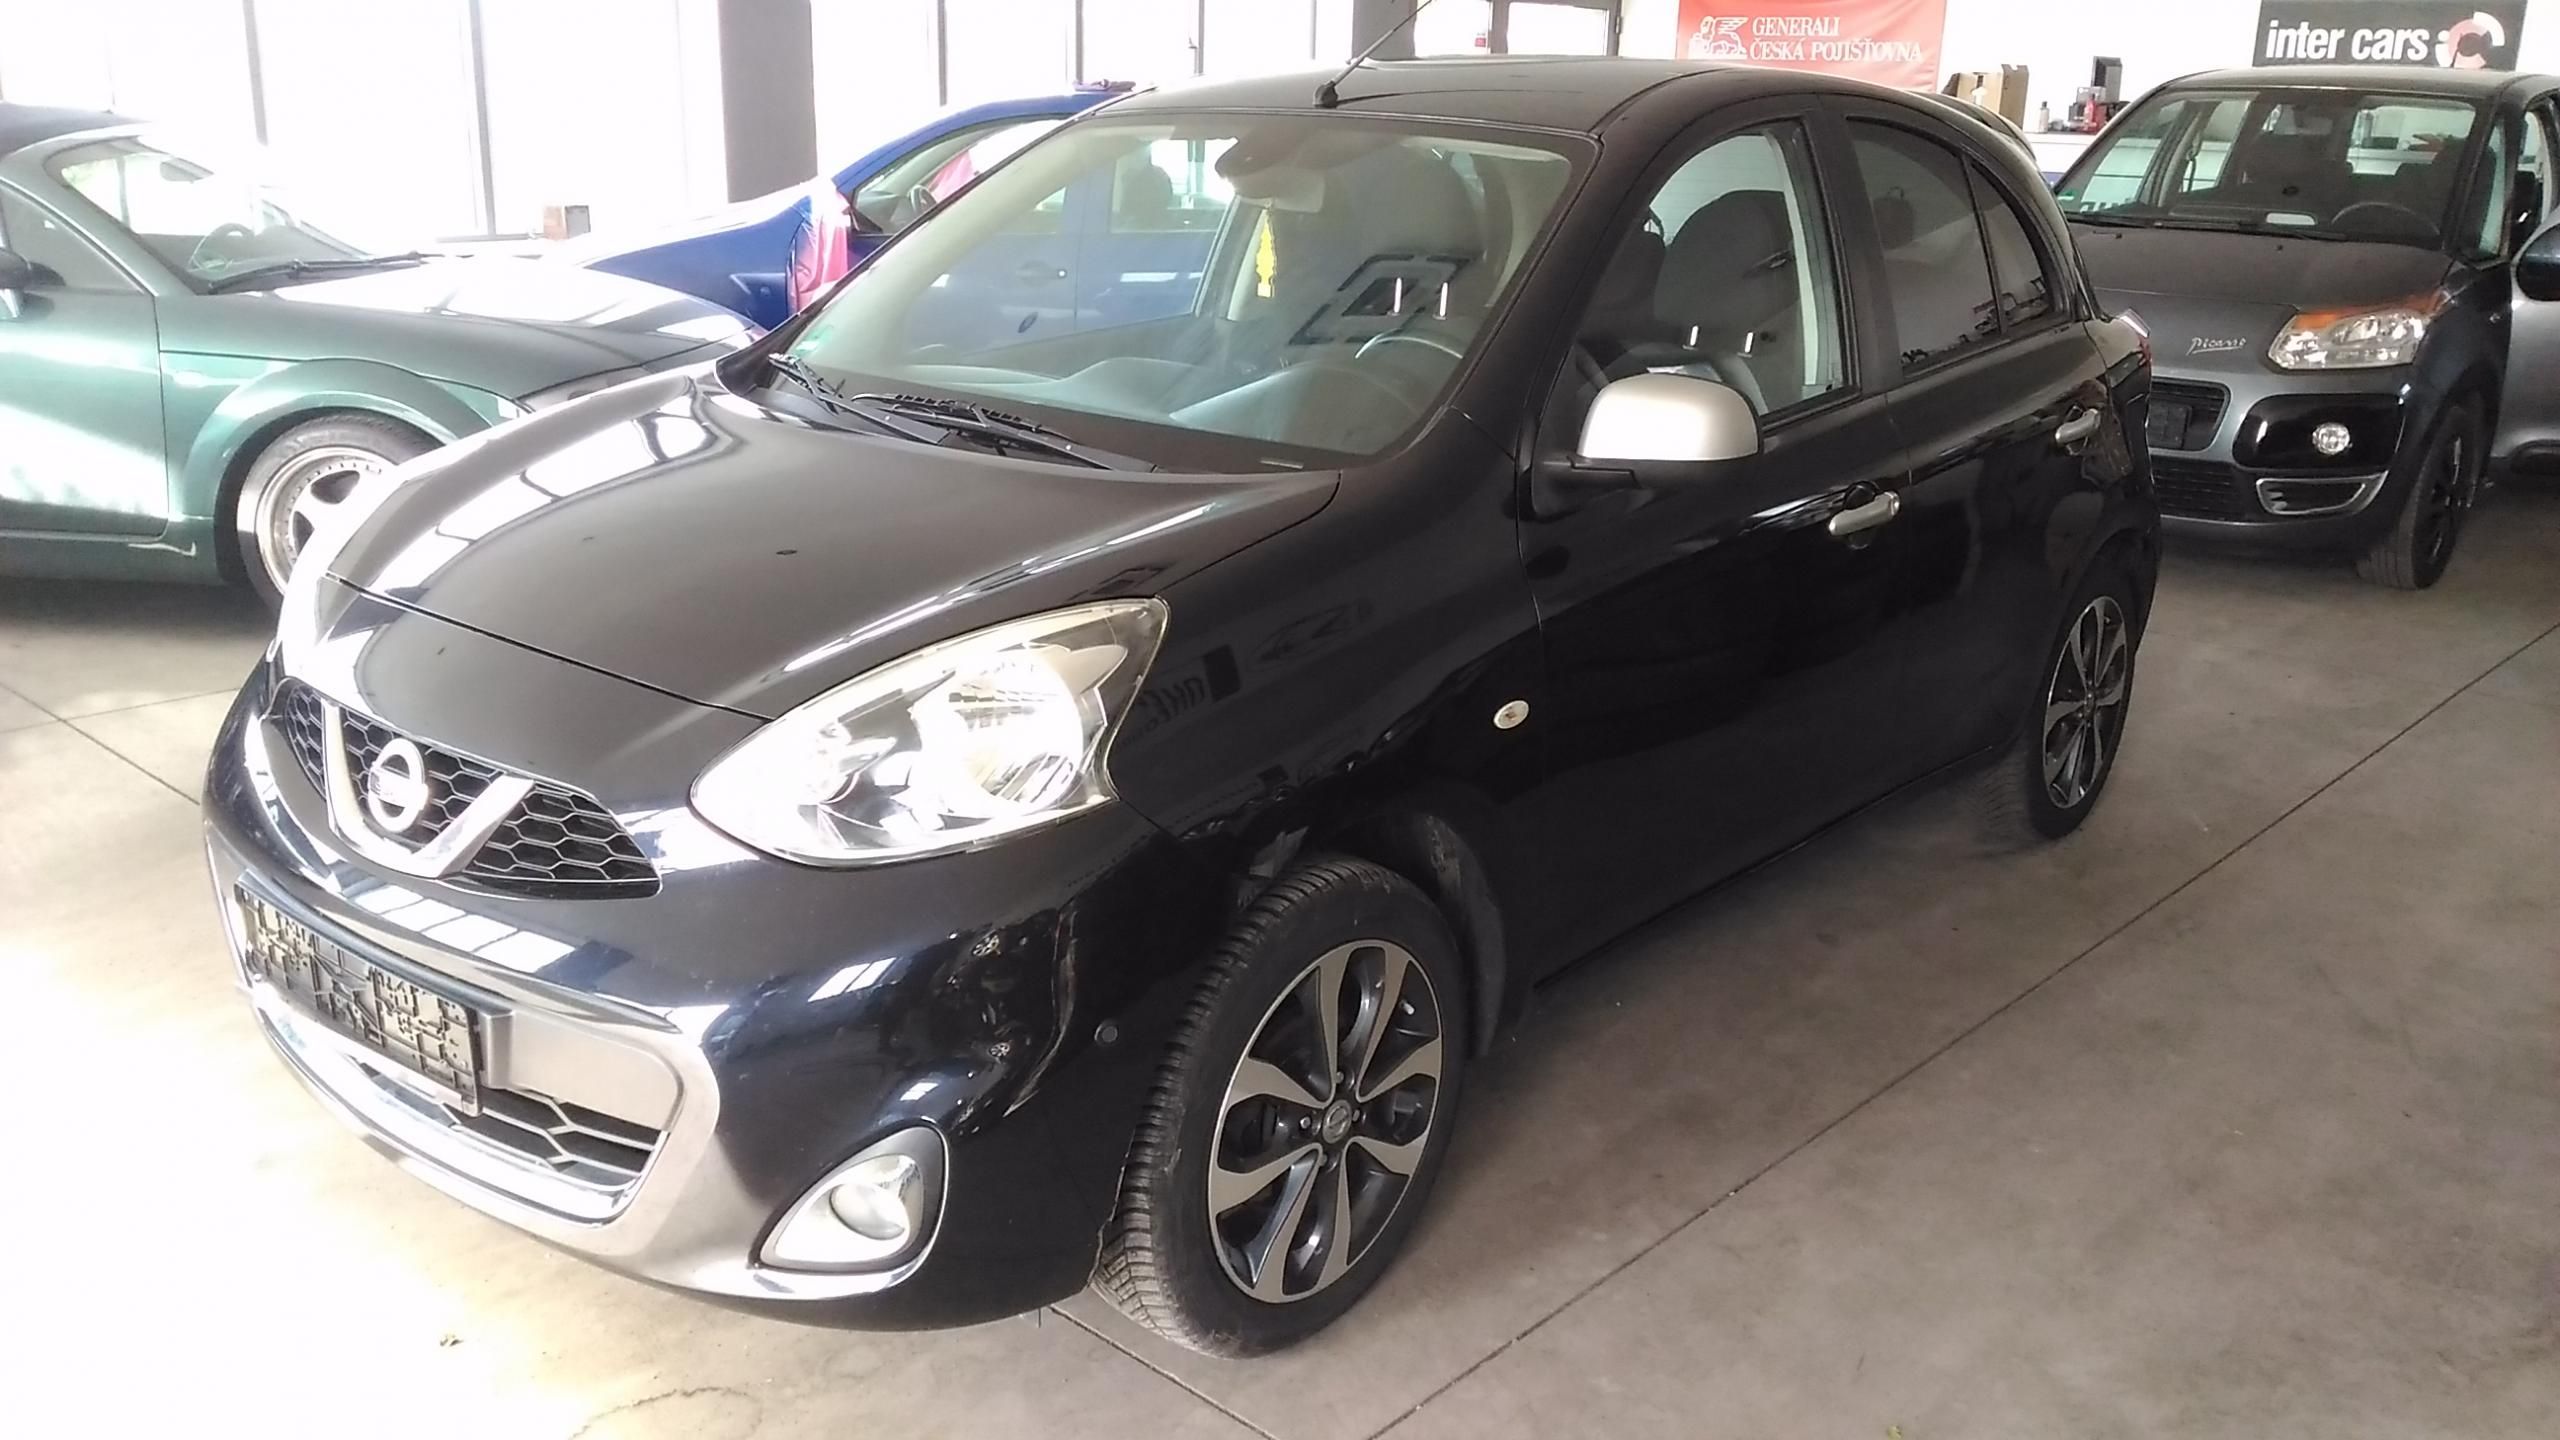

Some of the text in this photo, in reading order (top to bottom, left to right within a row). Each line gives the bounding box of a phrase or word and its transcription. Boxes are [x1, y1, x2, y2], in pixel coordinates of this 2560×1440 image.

[1752, 16, 1841, 37] GENERALI
[1750, 37, 1922, 63] ČESKÁ POJIŠŤOVNA
[2265, 20, 2430, 61] inter cars
